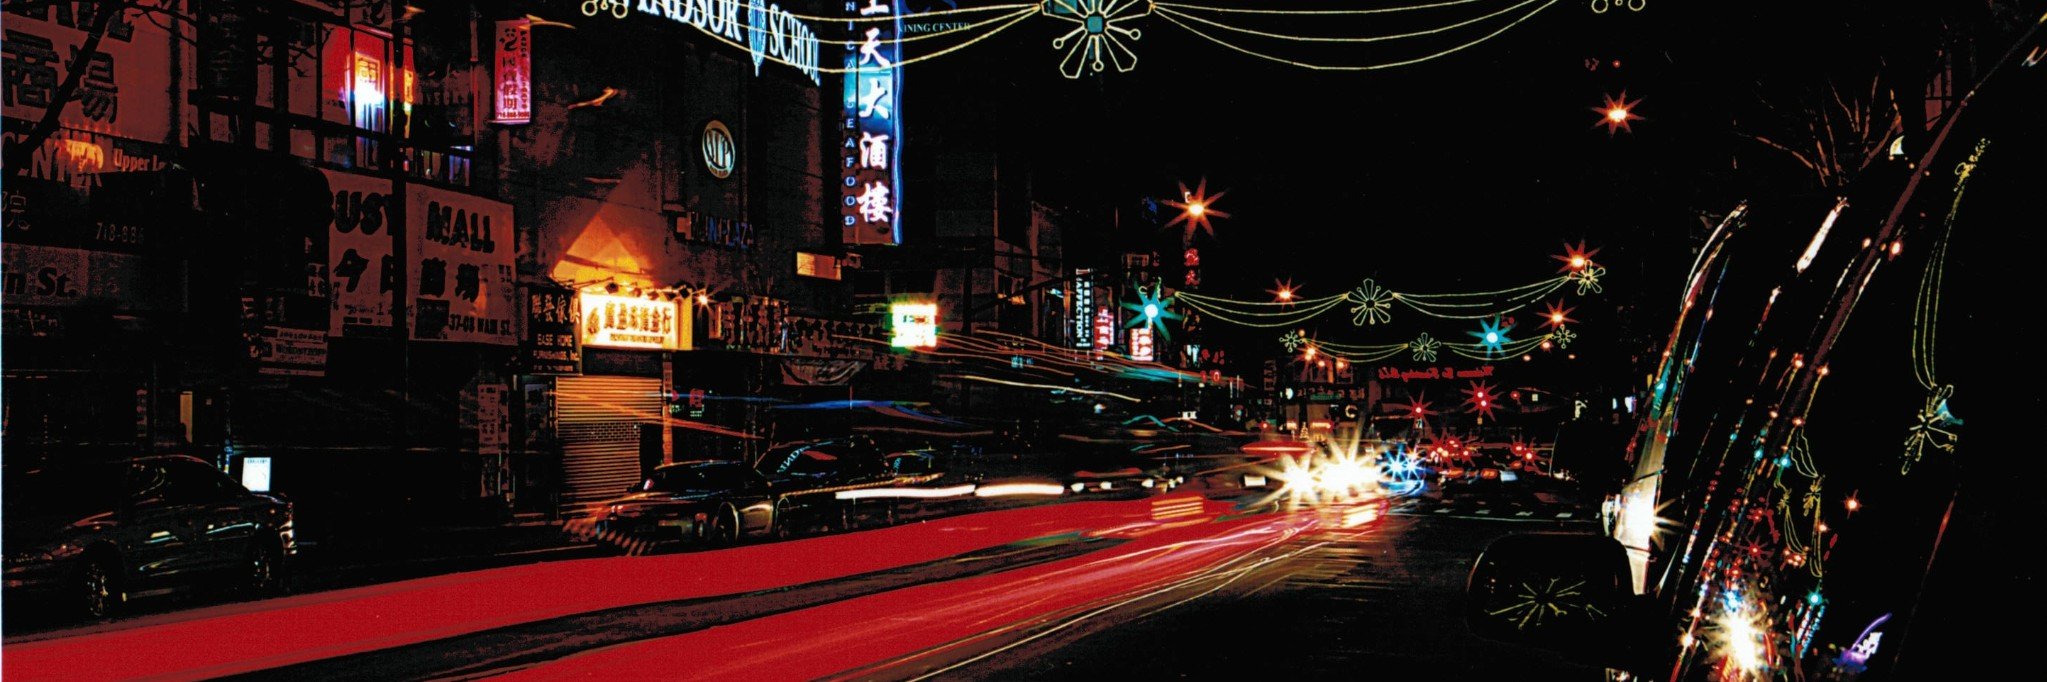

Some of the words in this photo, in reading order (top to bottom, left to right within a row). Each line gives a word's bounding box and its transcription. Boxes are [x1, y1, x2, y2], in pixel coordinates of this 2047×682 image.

[611, 0, 743, 42] DSOR
[768, 3, 820, 87] SCHOOL
[113, 148, 151, 172] Upper
[844, 101, 856, 225] SEAFOOD
[326, 190, 394, 236] USY
[426, 201, 495, 252] MALL
